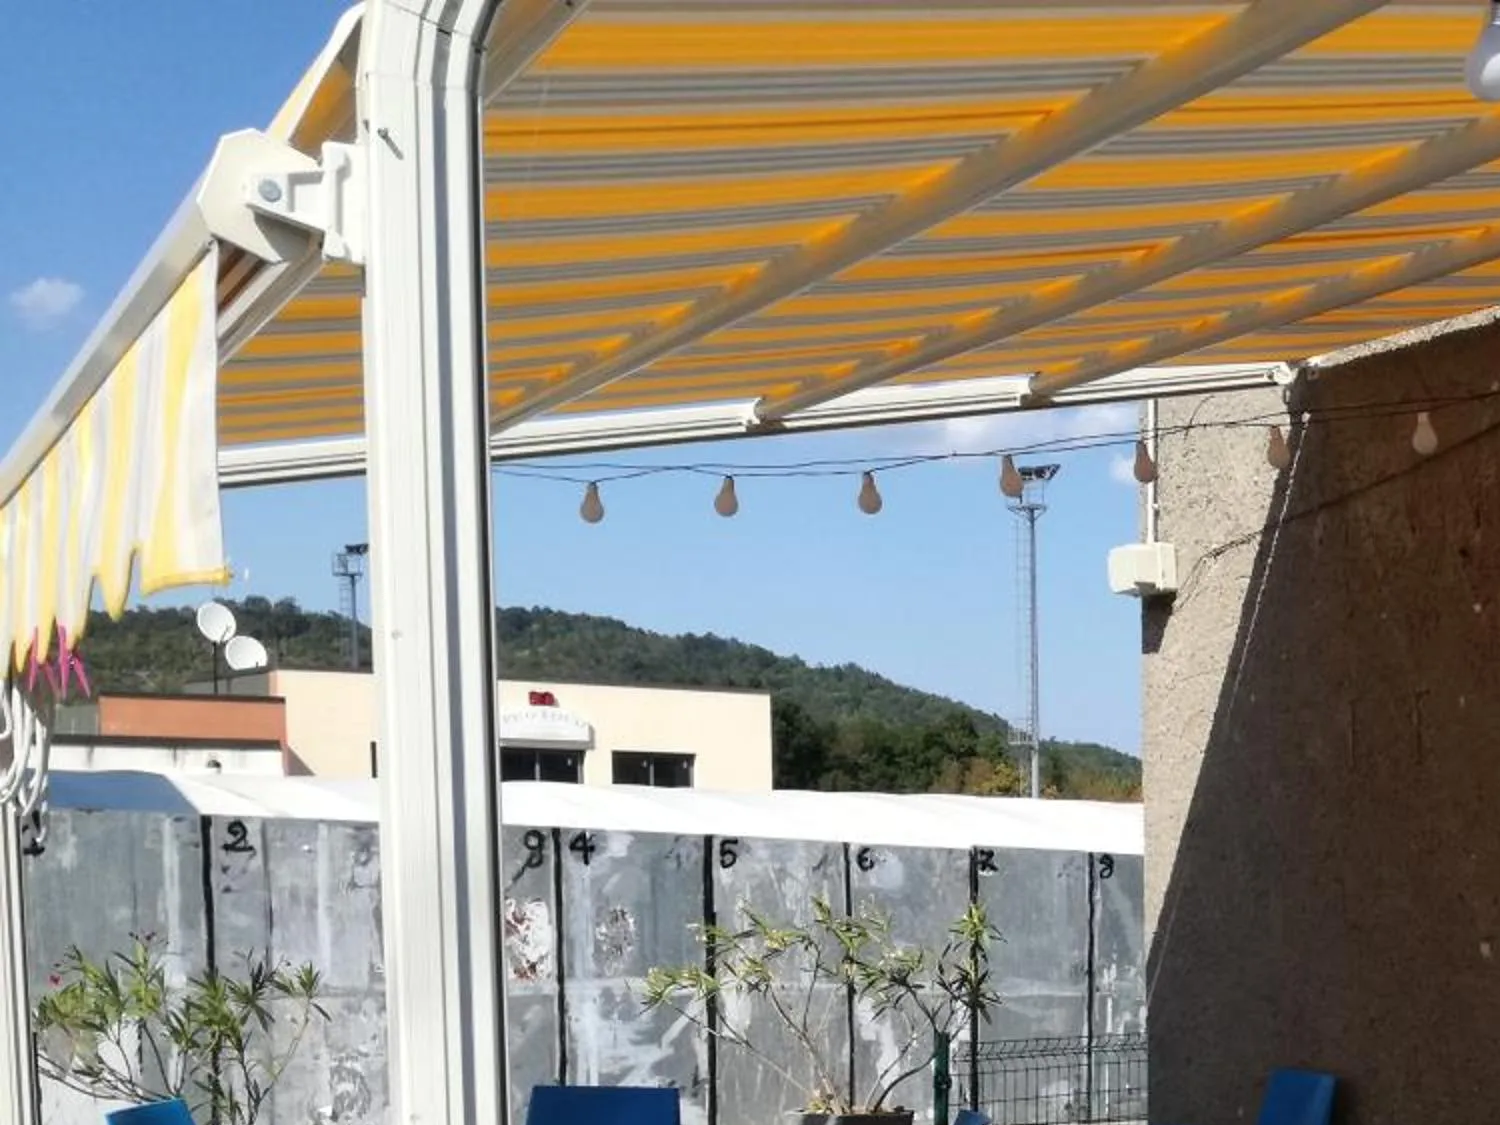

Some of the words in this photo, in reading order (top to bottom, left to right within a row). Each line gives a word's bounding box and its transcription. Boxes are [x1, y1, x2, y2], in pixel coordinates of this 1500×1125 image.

[222, 820, 256, 853] 2
[569, 830, 596, 865] 4
[719, 838, 738, 868] 5
